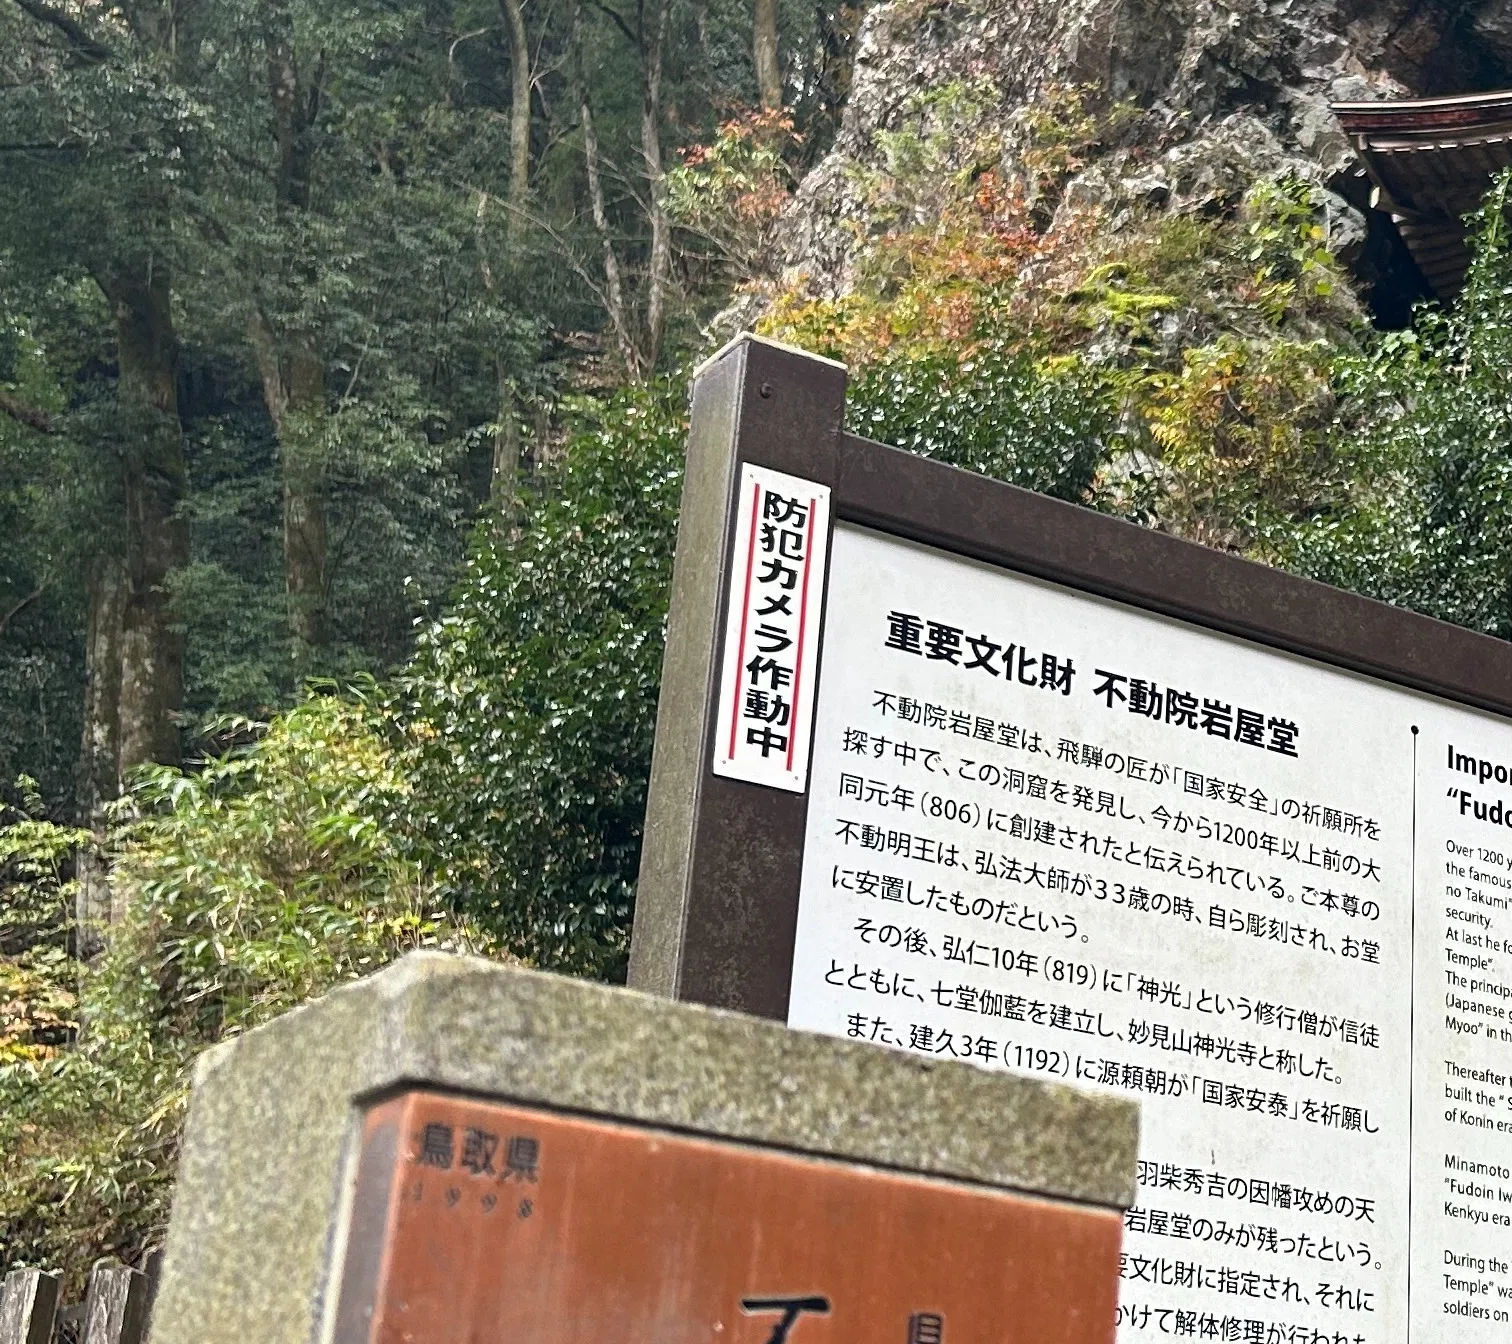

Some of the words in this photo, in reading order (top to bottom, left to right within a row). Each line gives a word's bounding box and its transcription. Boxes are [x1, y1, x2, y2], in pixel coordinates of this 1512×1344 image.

[744, 491, 808, 757] 防犯カメラ作動中
[885, 611, 1075, 695] 重要文化財
[1093, 669, 1298, 758] 不動院岩屋堂
[1444, 884, 1463, 899] no
[1444, 925, 1460, 943] At
[1460, 927, 1484, 949] last
[1484, 933, 1502, 953] he
[419, 1123, 540, 1183] 鳥取県
[1443, 1152, 1511, 1181] Minamoto
[1443, 1199, 1490, 1227] Kenkyu
[1490, 1212, 1512, 1228] era
[1442, 1248, 1487, 1275] During
[1487, 1255, 1510, 1276] the
[1442, 1298, 1492, 1321] soldiers
[1491, 1308, 1510, 1324] on
